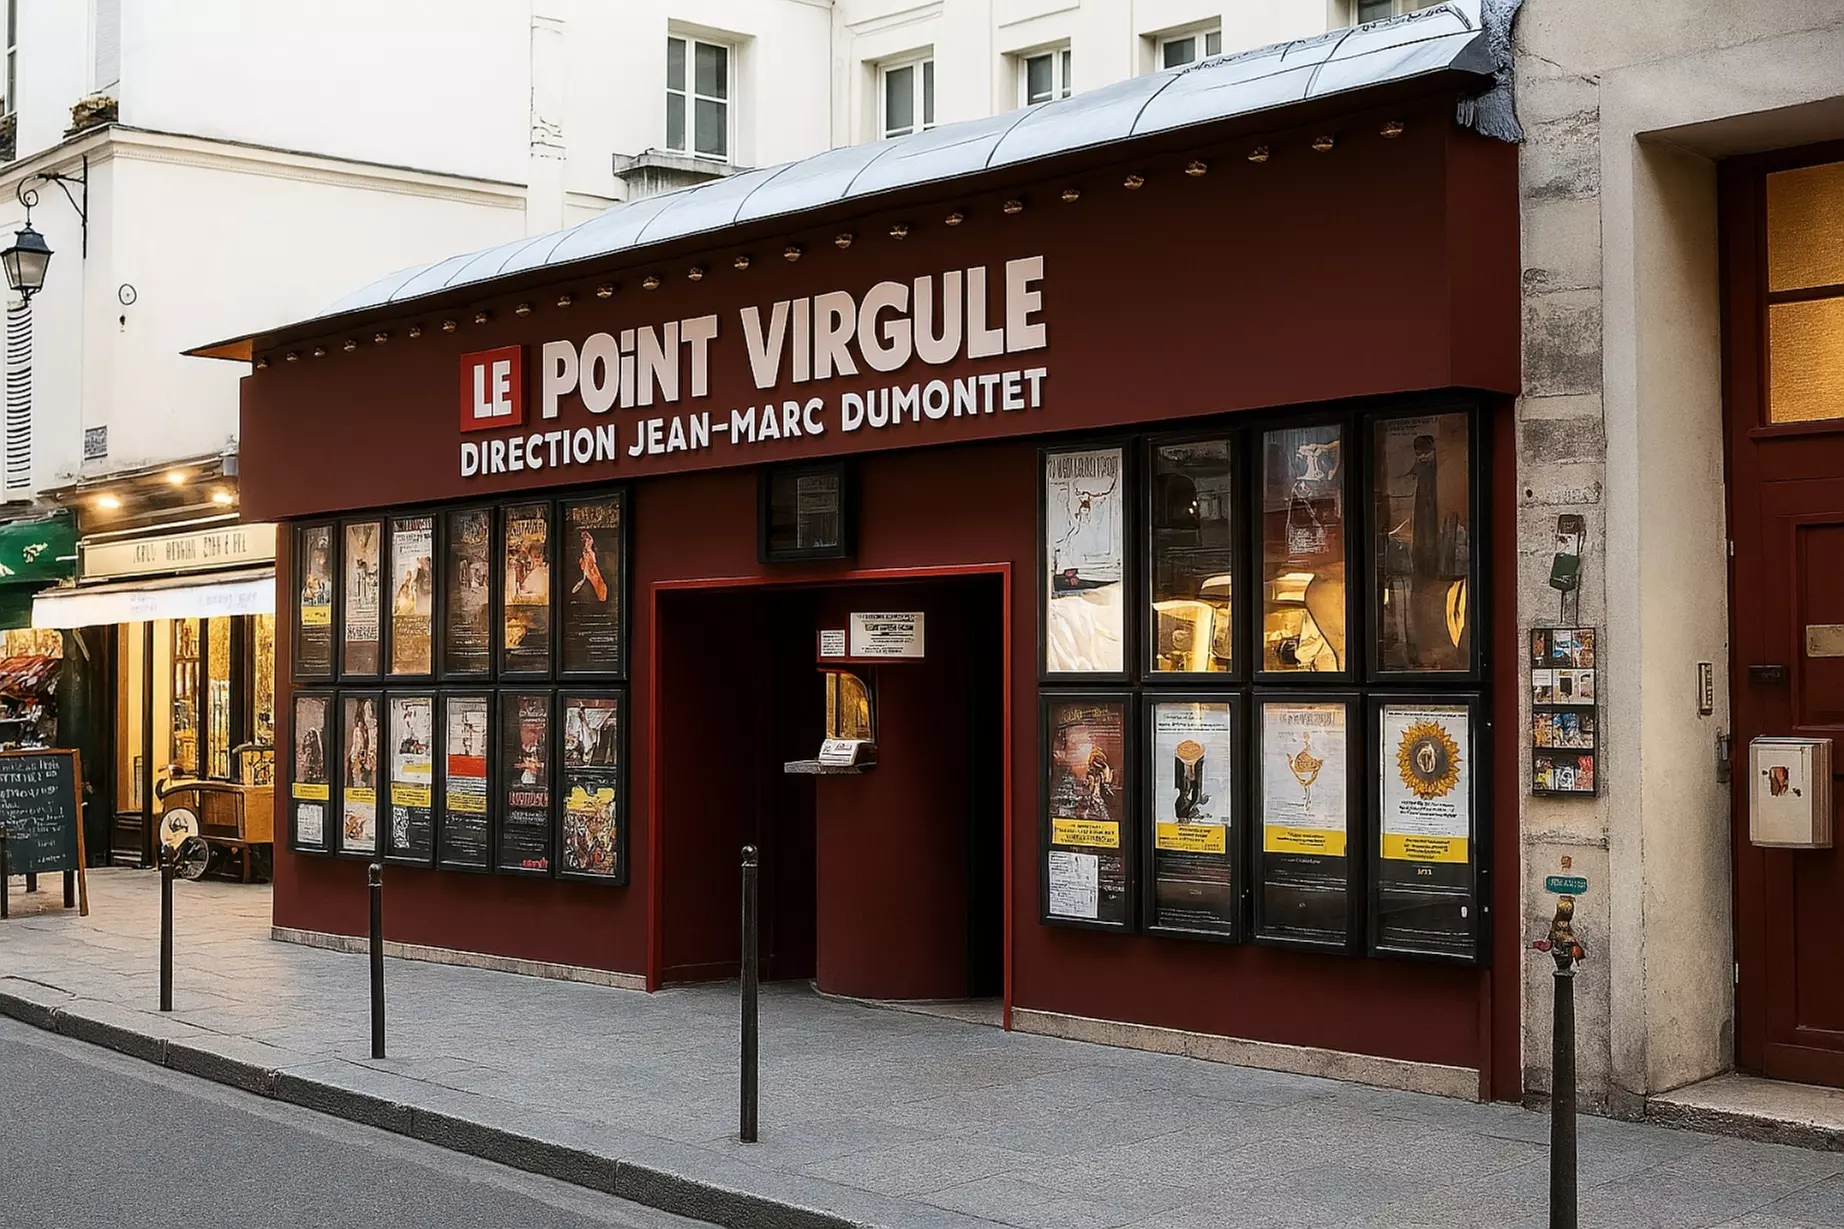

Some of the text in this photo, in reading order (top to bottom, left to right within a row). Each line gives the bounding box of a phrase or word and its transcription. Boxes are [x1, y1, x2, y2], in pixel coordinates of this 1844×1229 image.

[473, 359, 512, 419] LE
[739, 255, 1048, 389] VIRGULE
[460, 367, 1048, 478] DIRECTION JEAN-MARC DUMONTET
